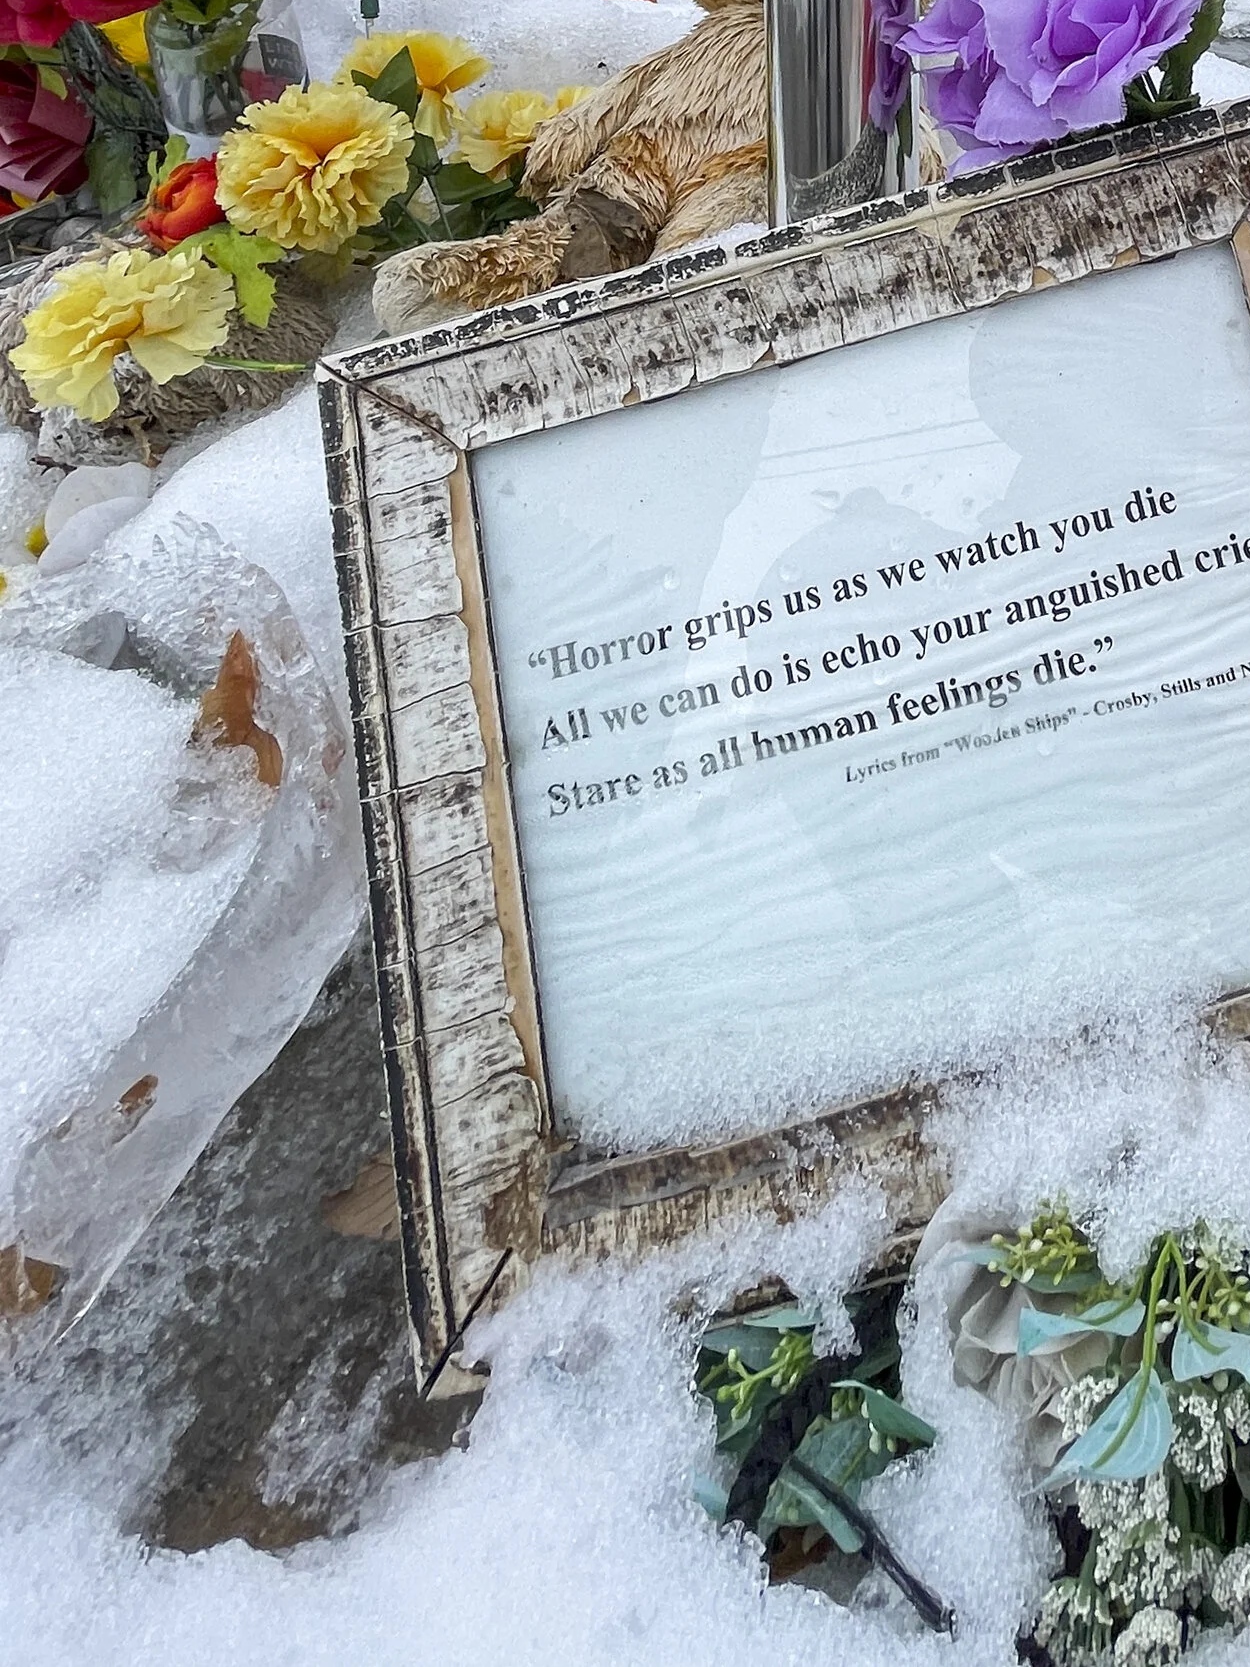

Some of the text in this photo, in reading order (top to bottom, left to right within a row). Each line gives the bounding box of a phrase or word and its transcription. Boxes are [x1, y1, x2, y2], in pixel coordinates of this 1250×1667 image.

[684, 597, 773, 651] grips
[782, 586, 821, 617] us
[832, 572, 868, 604] as
[877, 558, 926, 590] we
[934, 520, 1041, 575] watch
[1048, 507, 1114, 553] you
[1124, 486, 1178, 524] die
[540, 708, 593, 751] All
[599, 701, 649, 734] we
[658, 681, 720, 718] can
[730, 665, 773, 699] do
[782, 653, 811, 686] is
[821, 633, 901, 676] echo
[909, 606, 993, 660] your
[1004, 549, 1184, 626] anguished
[845, 756, 897, 784] Lyrics
[900, 745, 941, 767] from
[1093, 690, 1159, 718] Crosby,
[1160, 676, 1202, 700] Stills
[1204, 668, 1237, 689] and
[547, 772, 643, 818] Stare
[651, 759, 688, 790] as
[699, 735, 744, 778] all
[751, 706, 880, 762] human
[886, 665, 1022, 727] feelings
